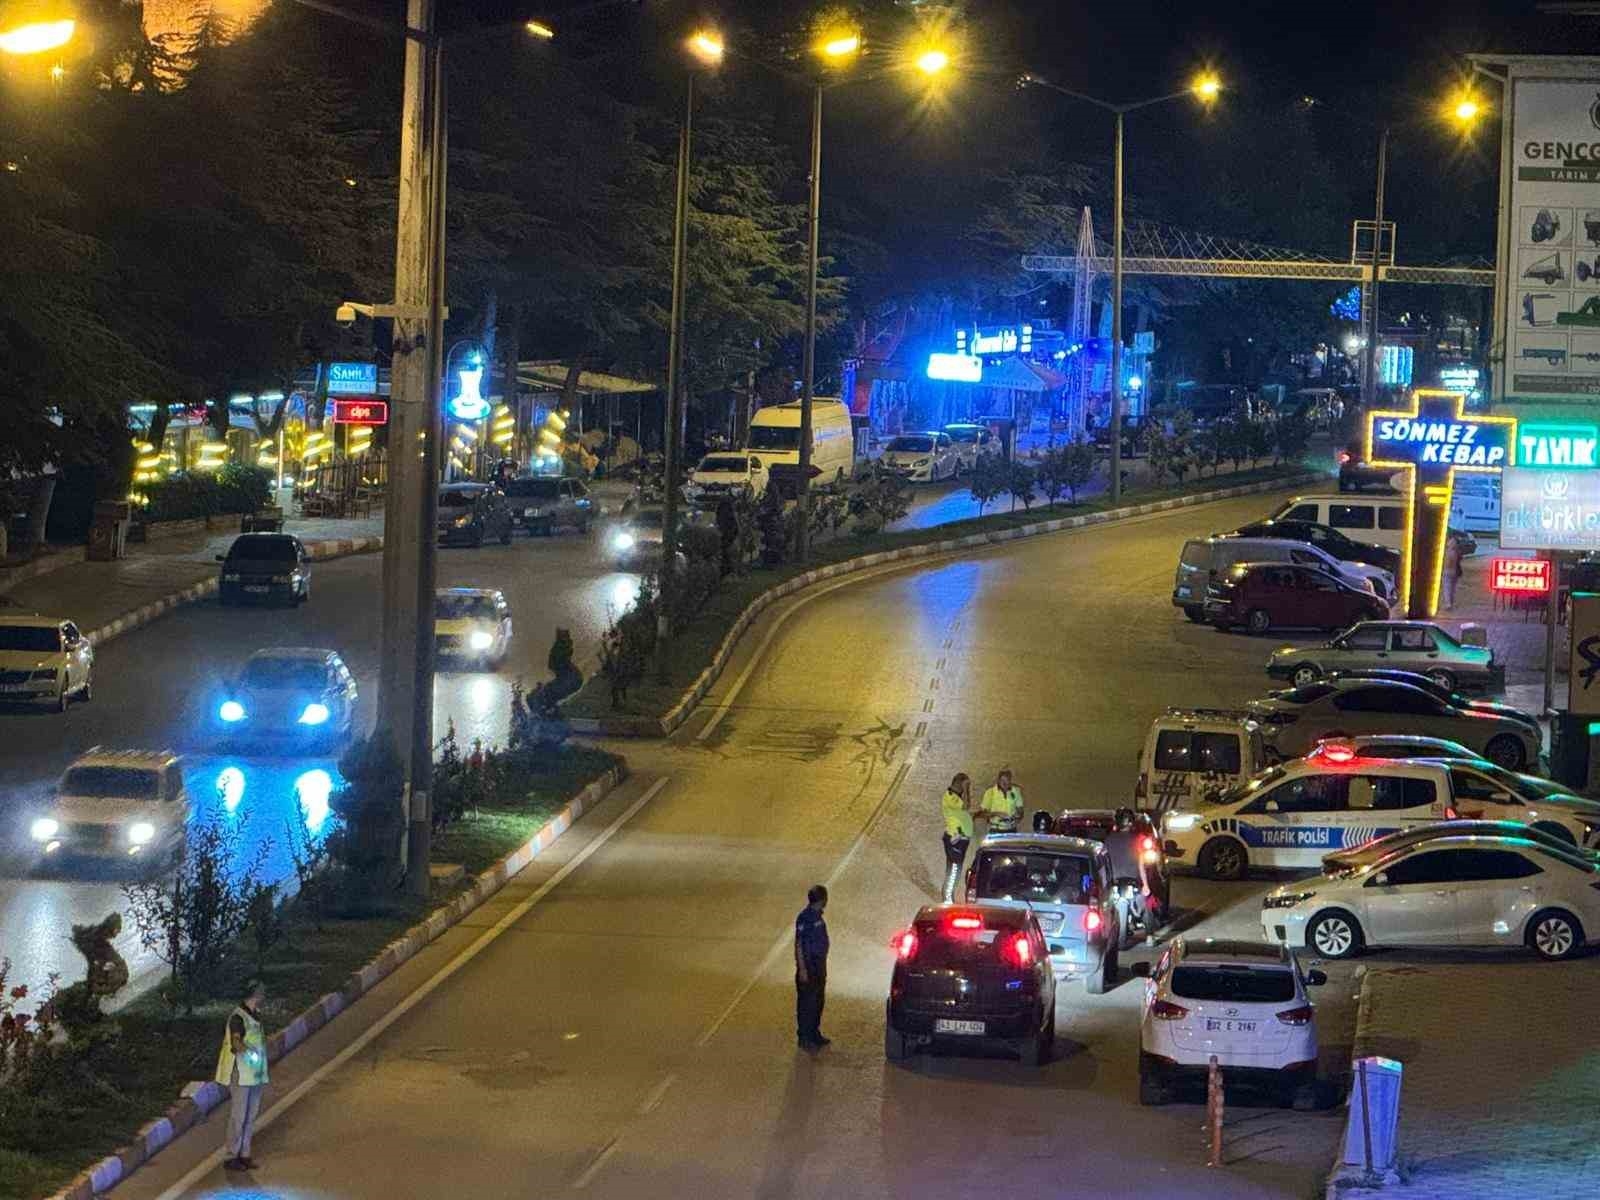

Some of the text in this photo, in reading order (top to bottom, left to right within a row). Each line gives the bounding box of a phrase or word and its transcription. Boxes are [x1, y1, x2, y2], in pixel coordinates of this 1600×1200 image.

[1379, 419, 1478, 444] SÖNMEZ
[1422, 443, 1504, 464] KEBAP
[1262, 828, 1330, 845] TRAFİK POLİSİ
